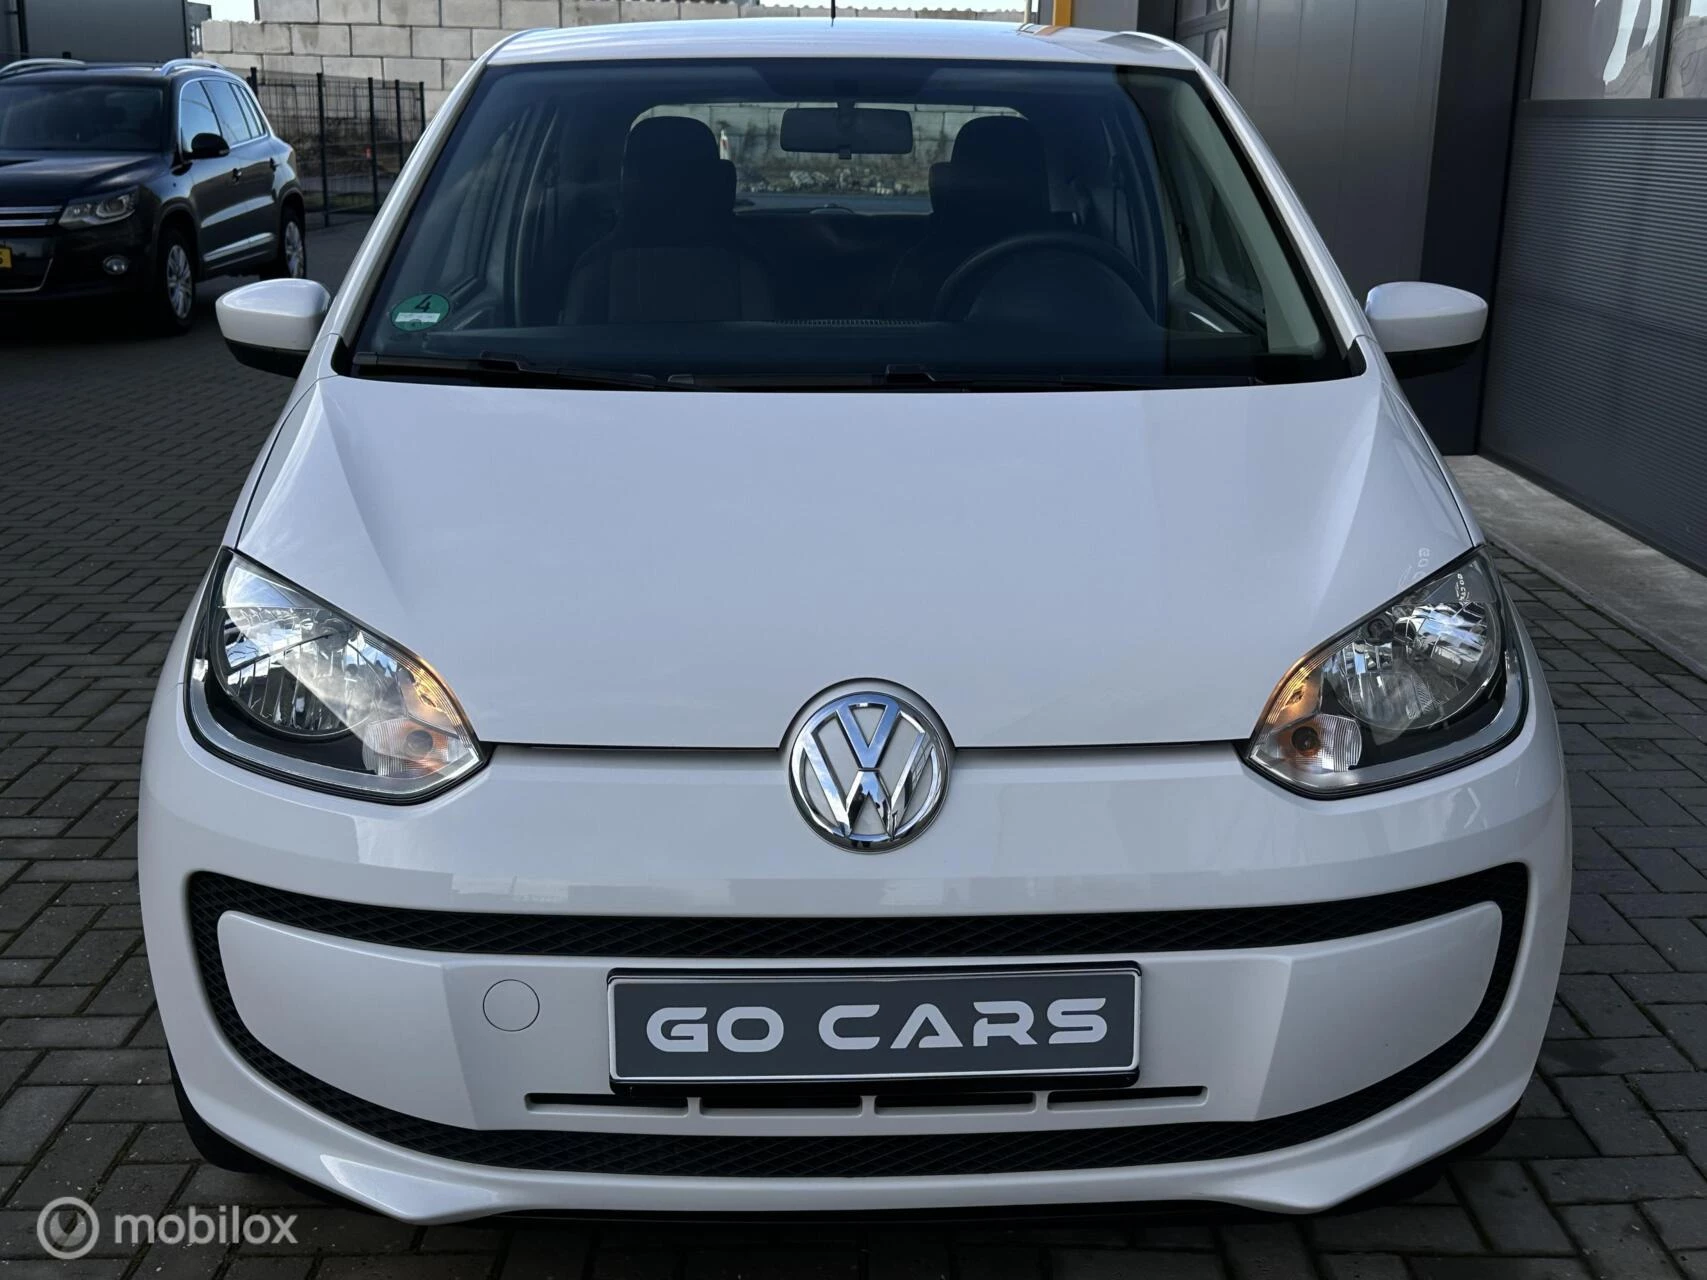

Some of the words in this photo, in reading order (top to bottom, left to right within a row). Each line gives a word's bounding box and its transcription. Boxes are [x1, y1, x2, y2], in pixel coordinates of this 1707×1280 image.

[414, 295, 432, 312] 4
[646, 1006, 784, 1053] GO
[818, 997, 1107, 1050] CARS
